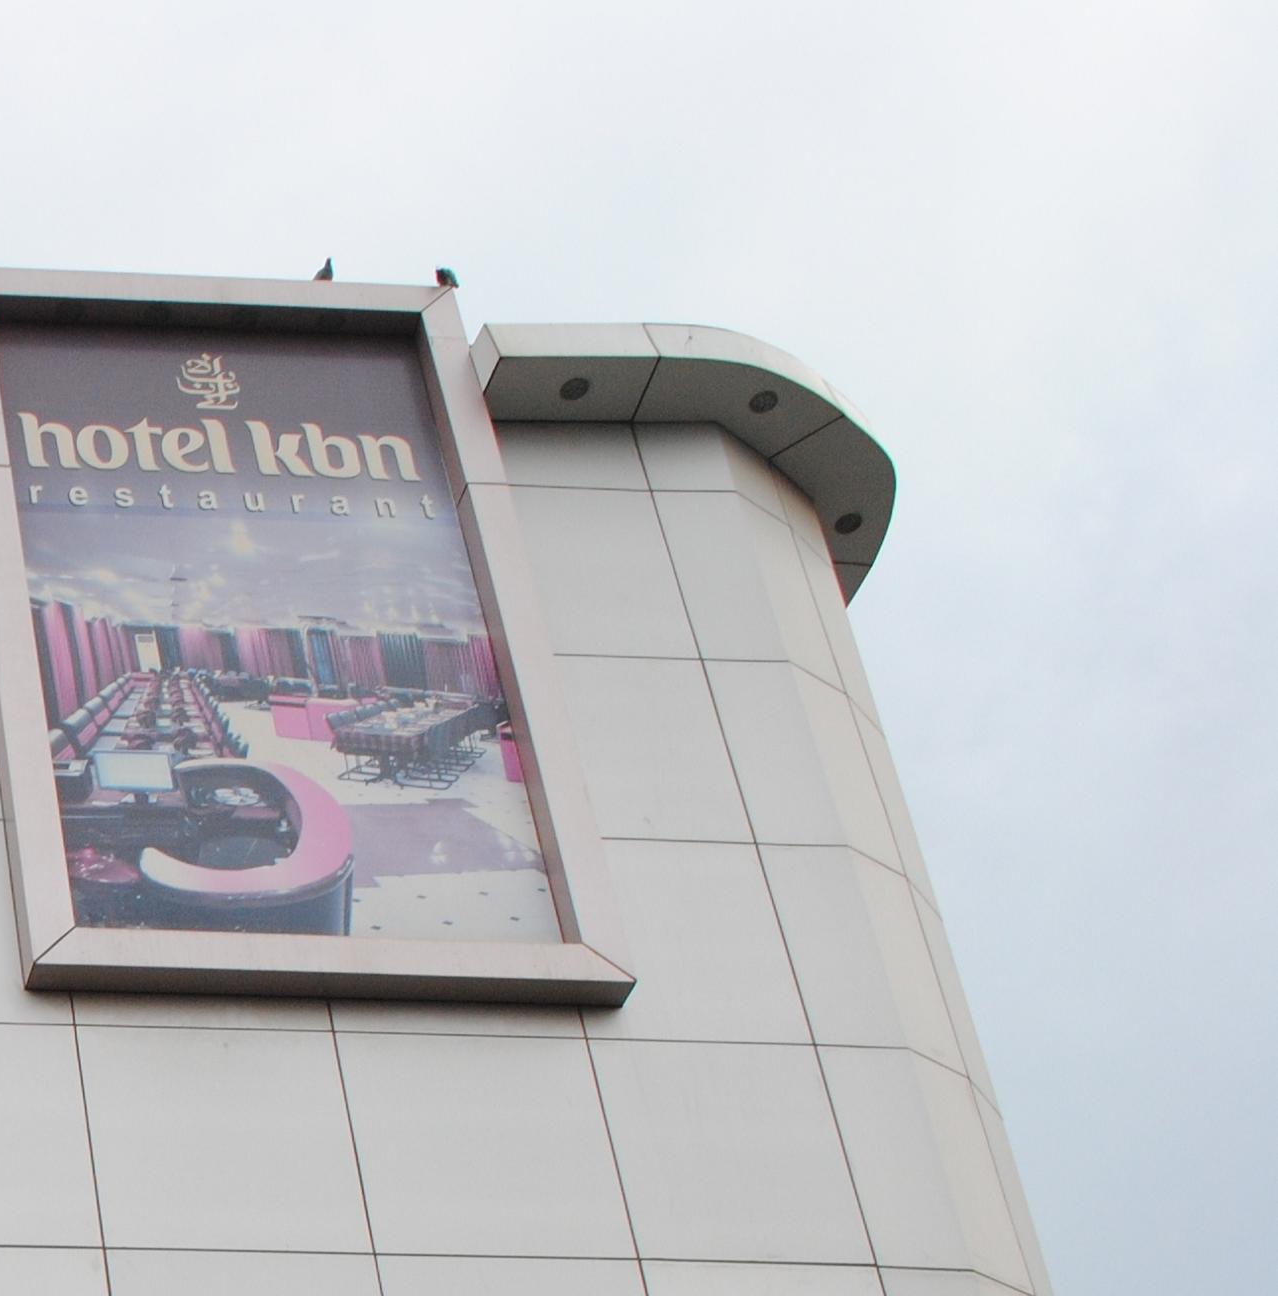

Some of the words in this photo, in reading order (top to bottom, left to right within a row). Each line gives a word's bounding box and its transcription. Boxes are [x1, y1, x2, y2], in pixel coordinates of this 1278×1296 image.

[18, 413, 237, 475] hotel
[245, 420, 421, 483] kbn
[30, 482, 436, 520] restaurant
